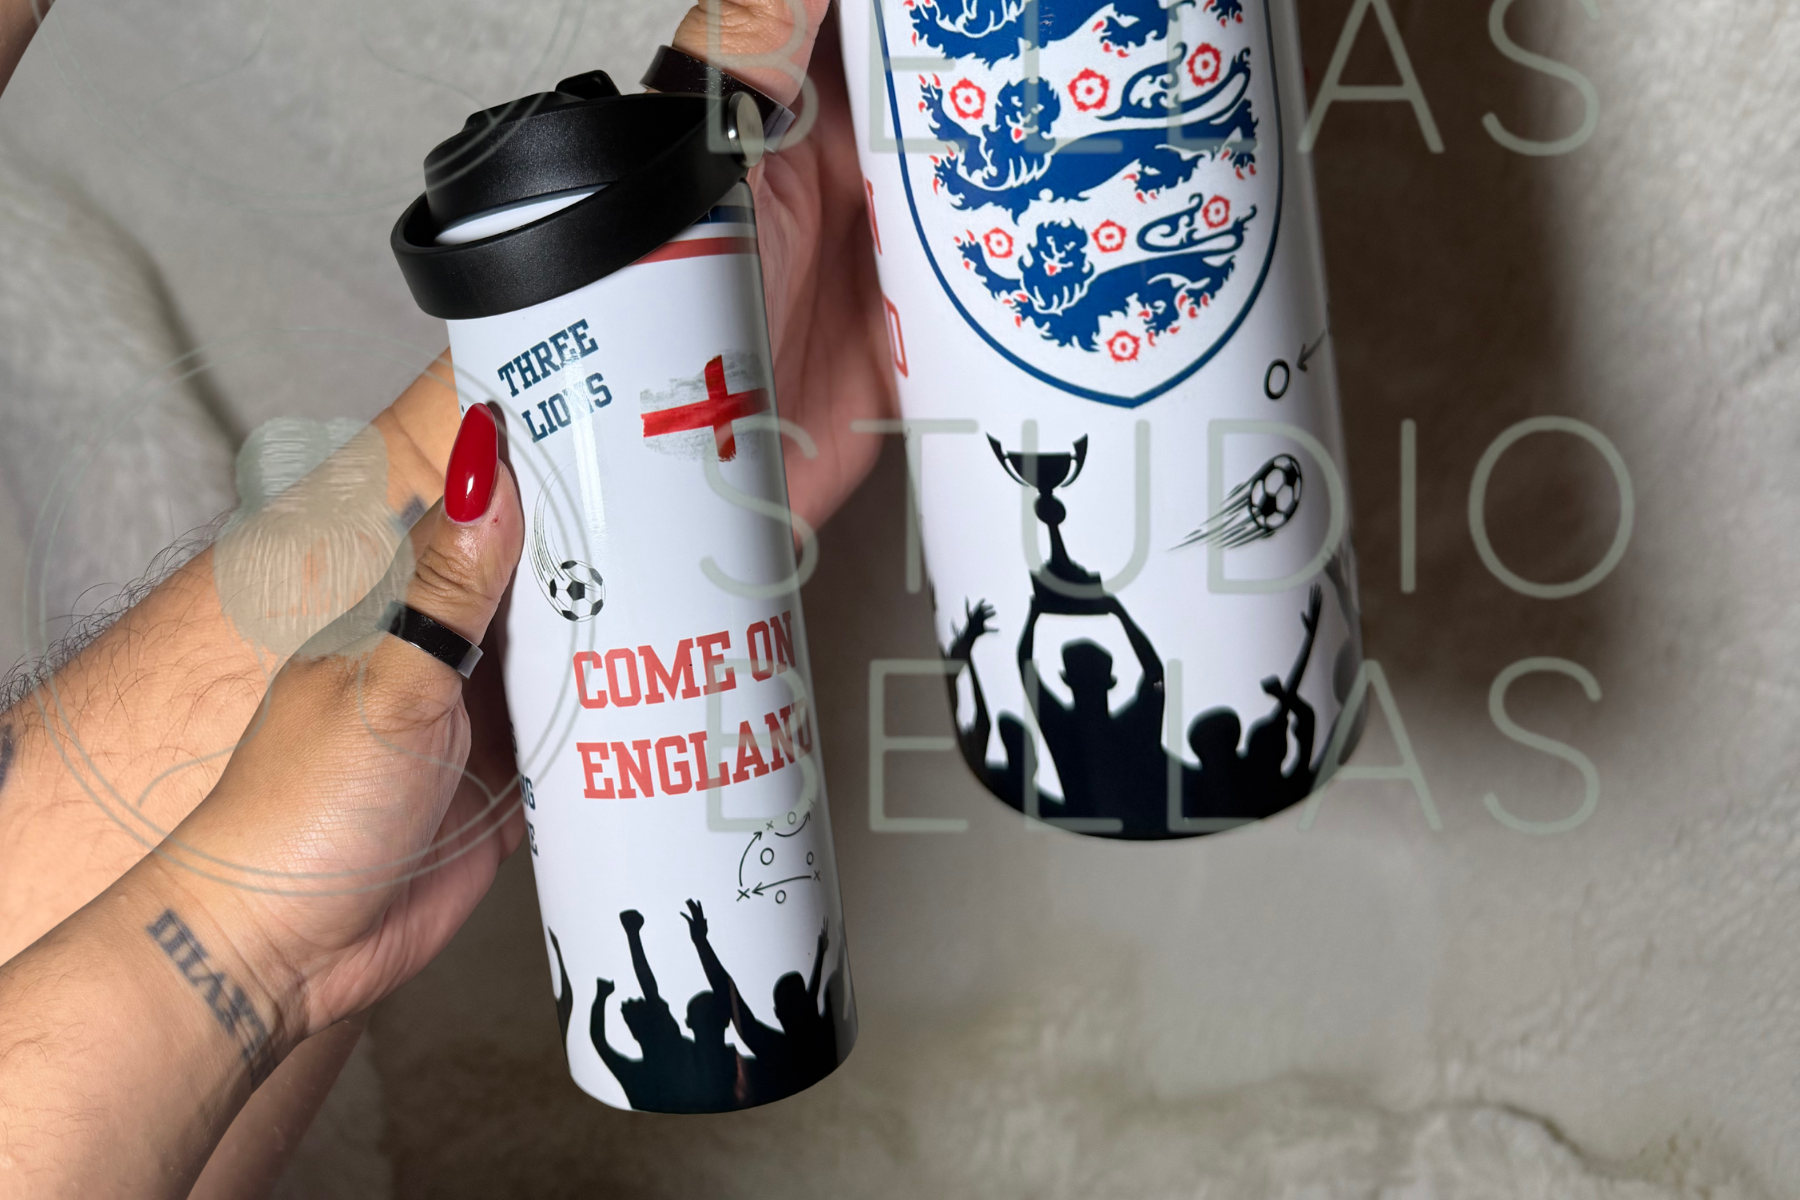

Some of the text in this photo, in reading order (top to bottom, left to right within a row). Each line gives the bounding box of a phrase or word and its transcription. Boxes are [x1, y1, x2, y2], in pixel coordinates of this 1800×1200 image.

[497, 318, 599, 398] THREE
[573, 610, 797, 710] COME ON
[576, 697, 813, 799] ENGLAND
